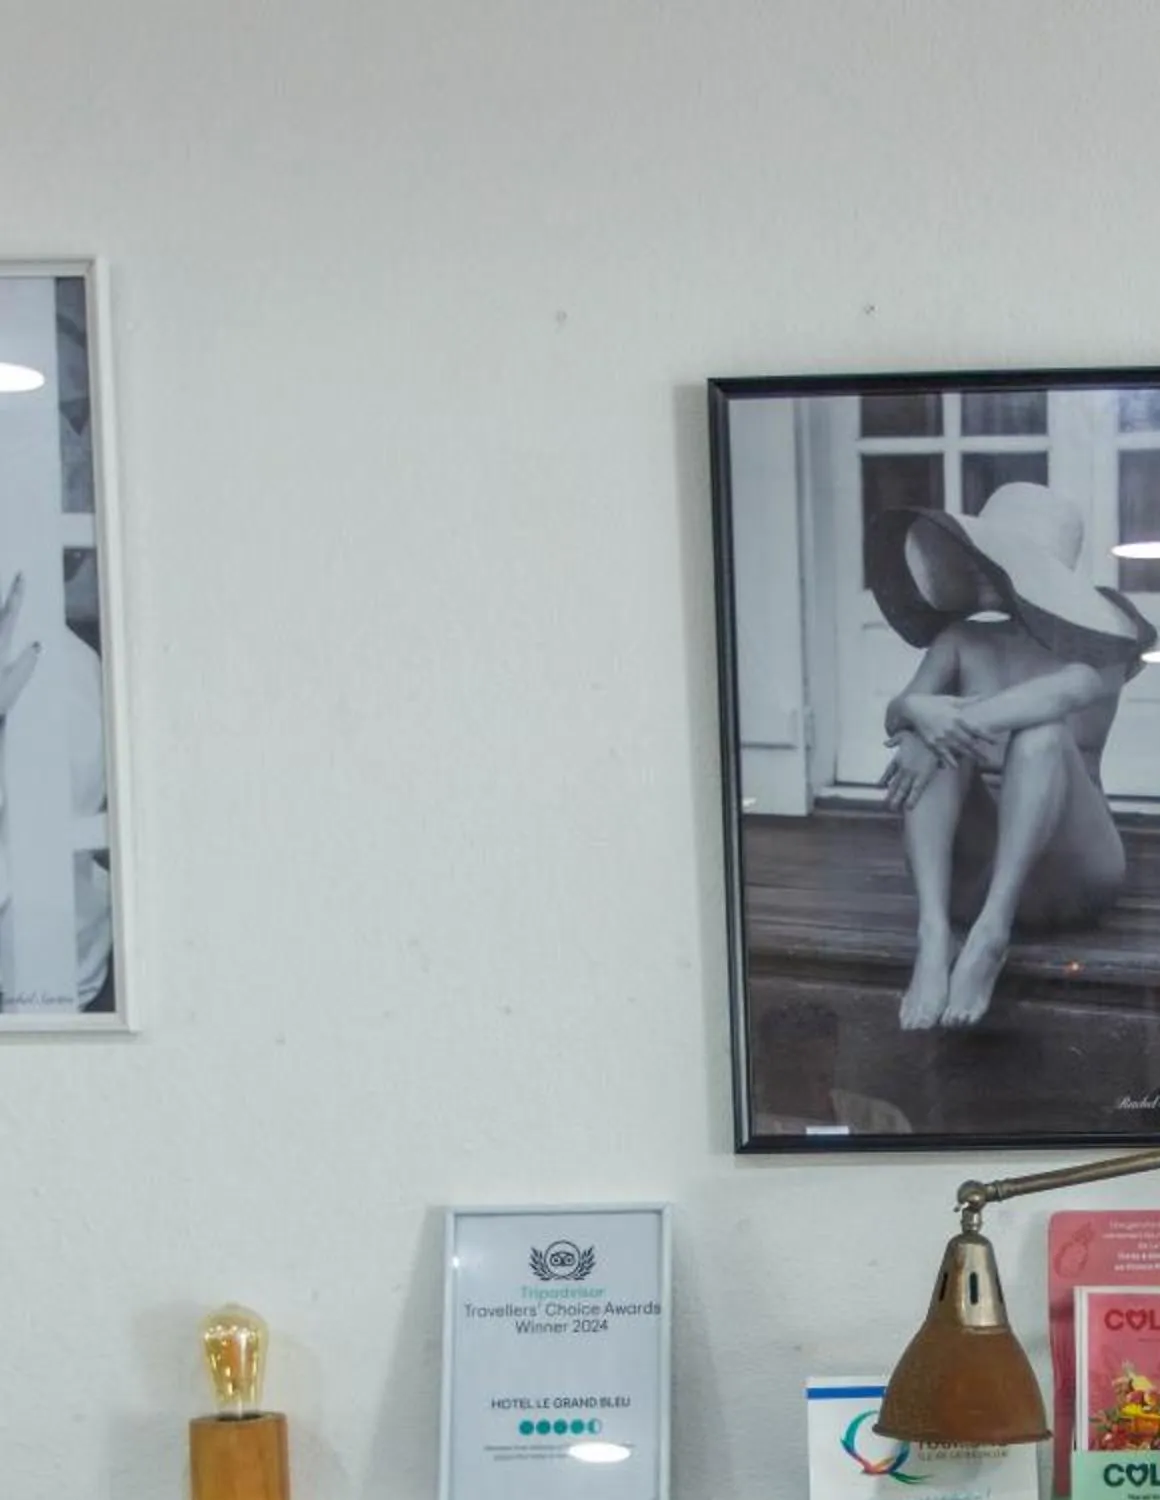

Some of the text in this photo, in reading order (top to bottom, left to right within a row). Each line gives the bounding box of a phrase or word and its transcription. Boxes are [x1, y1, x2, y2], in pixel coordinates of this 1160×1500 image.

[520, 1285, 606, 1300] Tripadvisor
[464, 1300, 661, 1318] Travellers' Choice Awards
[515, 1318, 609, 1334] Winner 2024
[491, 1396, 631, 1409] HOTEL LE GRAND BLEU
